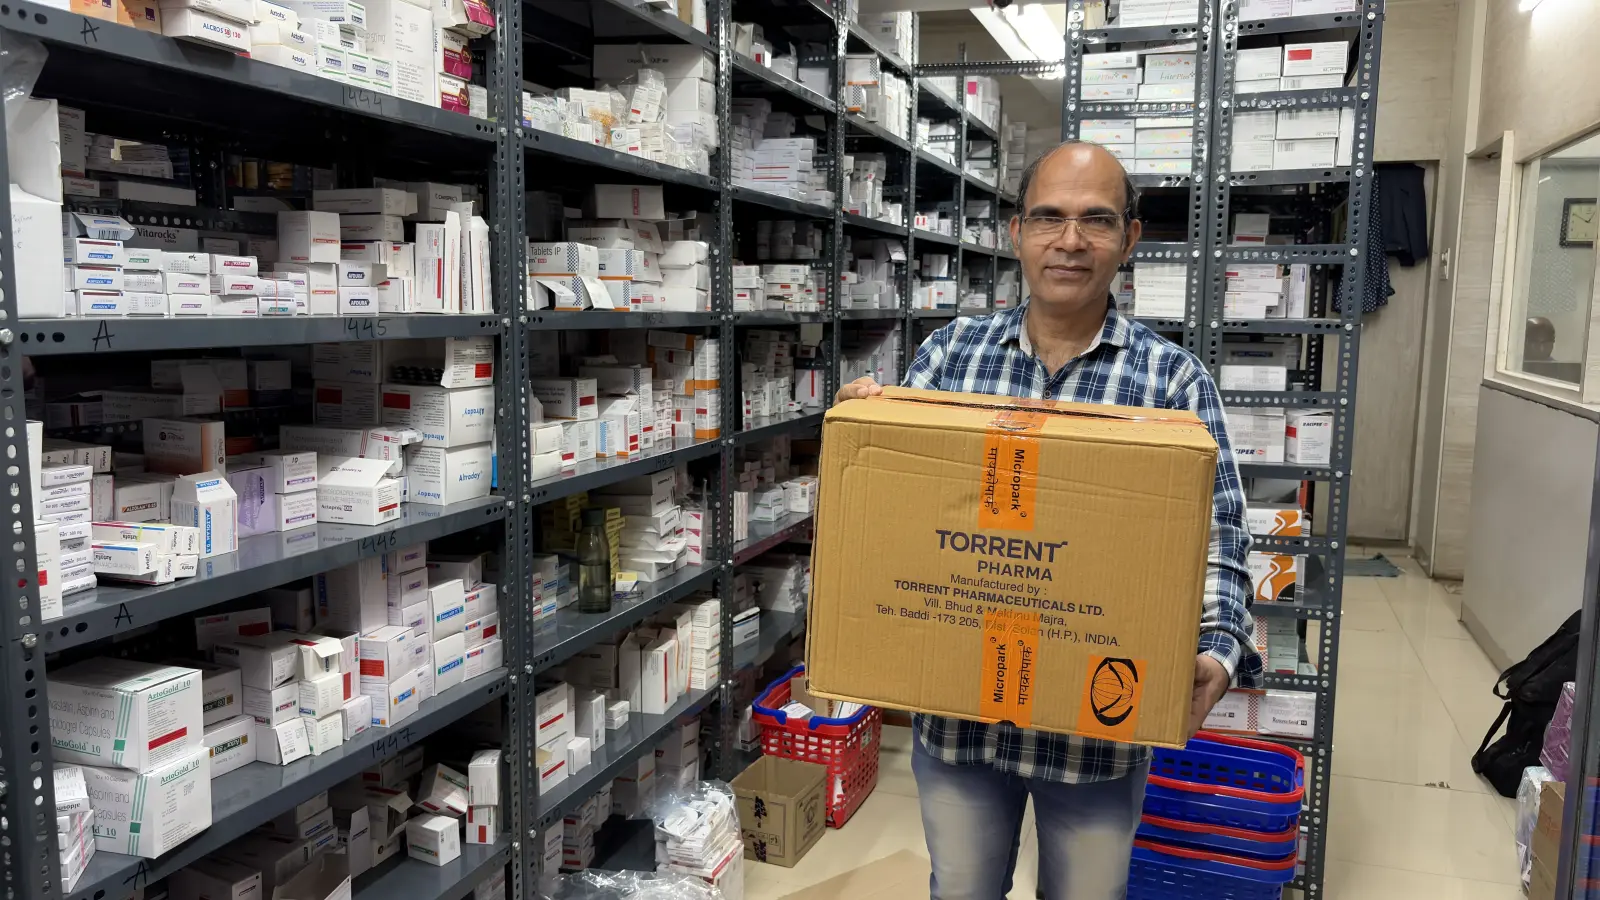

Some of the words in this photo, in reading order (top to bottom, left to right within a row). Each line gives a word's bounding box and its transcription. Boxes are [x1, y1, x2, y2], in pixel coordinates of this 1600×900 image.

[80, 17, 99, 44] A
[342, 86, 382, 112] 1444
[136, 227, 177, 240] Vitarocks
[530, 246, 552, 256] Tablets
[554, 246, 561, 255] IP
[92, 320, 115, 349] A
[344, 318, 390, 339] 1445
[423, 433, 445, 441] Altrada
[458, 471, 481, 482] Altraday
[1010, 449, 1025, 511] Micropark
[357, 531, 396, 554] 1446
[936, 530, 1067, 562] TORRENT
[978, 560, 1052, 581] PHARMA
[950, 574, 1024, 592] Manufactured
[1027, 583, 1040, 596] by
[894, 580, 950, 596] TORRENT
[953, 588, 1075, 613] PHARMACEUTICALS
[1079, 604, 1105, 617] LTD.
[113, 602, 134, 628] A
[924, 597, 941, 608] Vill.
[945, 600, 973, 613] Bhud
[976, 605, 983, 615] &
[1034, 612, 1067, 626] Majra,
[876, 604, 896, 616] Teh.
[900, 608, 930, 620] Baddi
[933, 613, 956, 625] -173
[959, 616, 981, 630] 205,
[1047, 628, 1080, 643] (H.P.),
[1085, 633, 1120, 647] INDIA.
[993, 643, 1007, 703] Micropark
[147, 682, 181, 700] AztoGold
[182, 679, 191, 688] 10
[100, 706, 115, 720] and
[79, 720, 111, 740] Capsules
[52, 737, 86, 751] AztoGold
[91, 744, 101, 753] 10
[371, 729, 415, 757] 1447
[160, 763, 189, 784] AztoGold
[192, 759, 200, 768] 10
[89, 785, 113, 803] Aspirin
[115, 790, 130, 804] and
[57, 802, 81, 812] aldosm
[106, 825, 117, 836] 10
[122, 861, 149, 890] A
